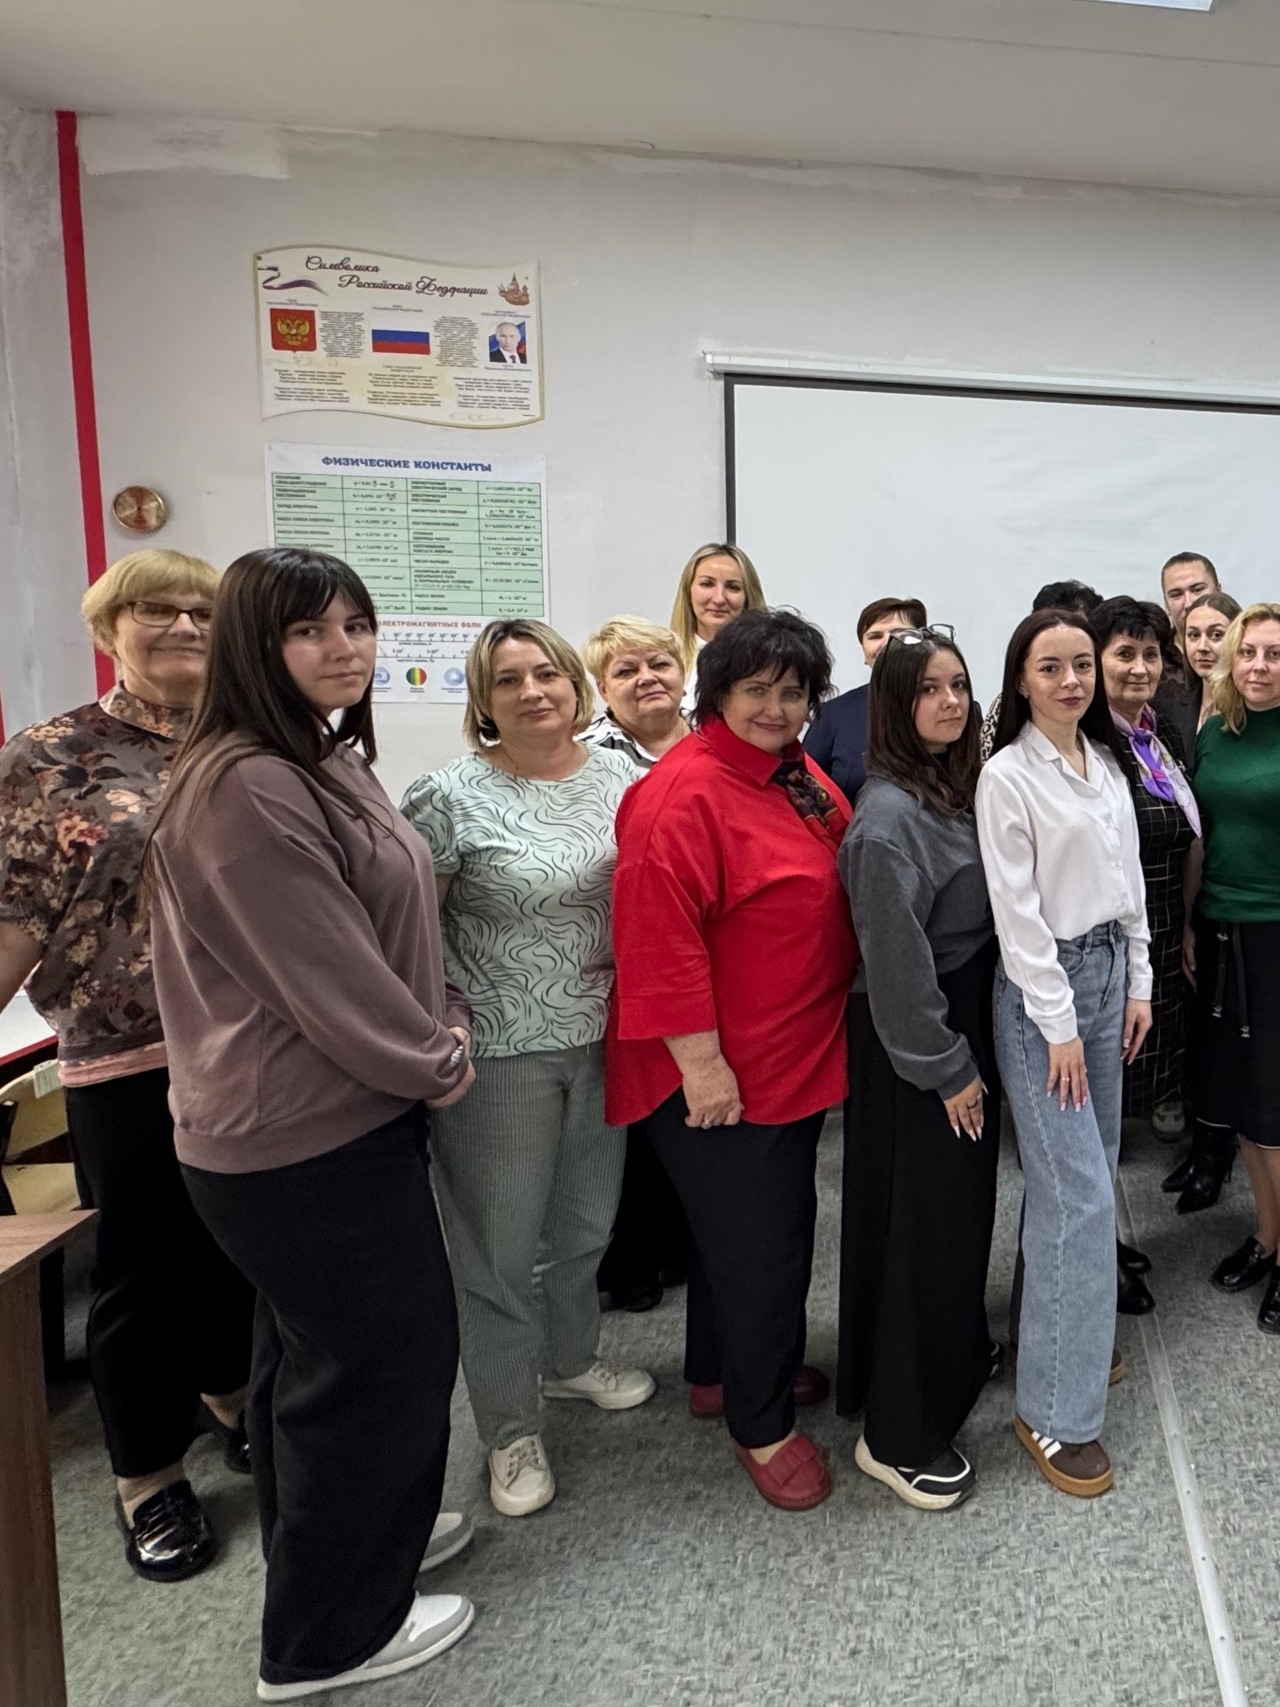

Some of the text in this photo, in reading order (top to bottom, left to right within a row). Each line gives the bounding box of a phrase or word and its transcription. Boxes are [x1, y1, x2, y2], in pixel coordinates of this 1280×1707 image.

[305, 255, 380, 273] Символика
[338, 274, 489, 298] Российской Федерации
[322, 456, 492, 472] ФИЗИЧЕСКИЕ КОНСТАНТЫ
